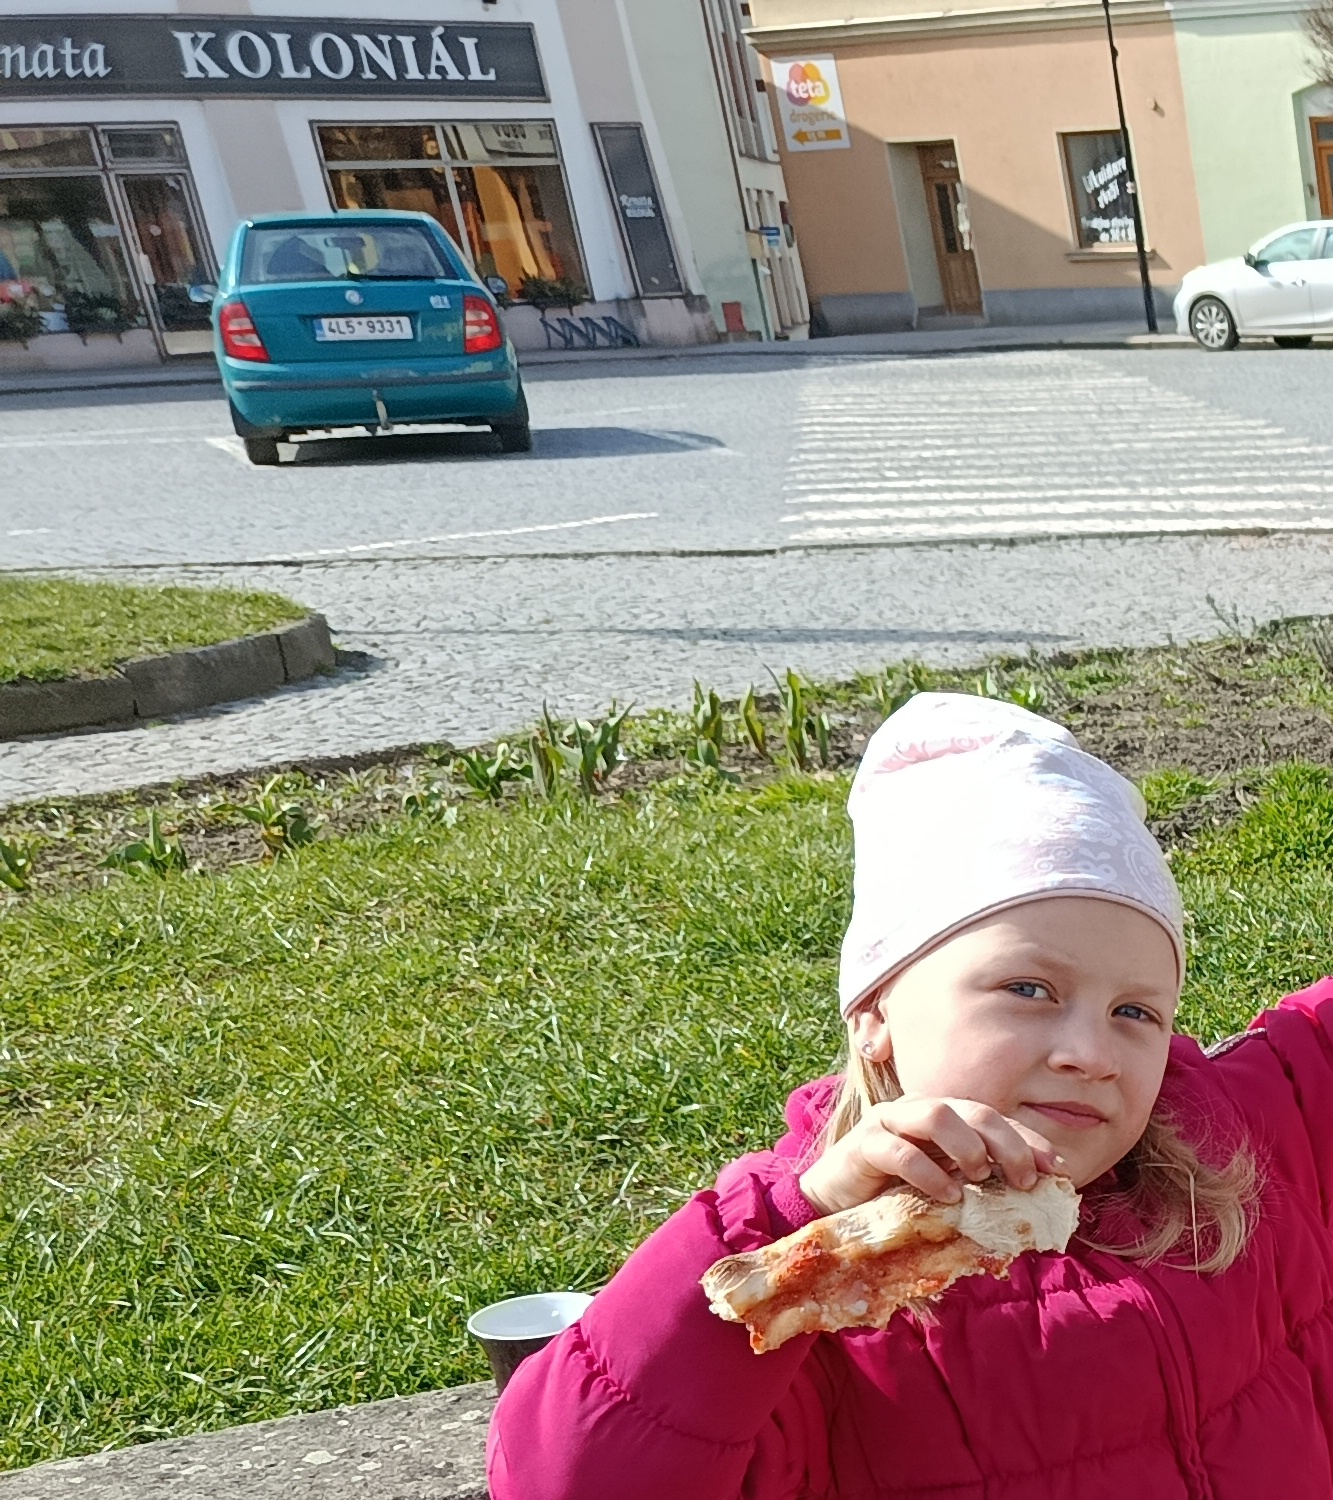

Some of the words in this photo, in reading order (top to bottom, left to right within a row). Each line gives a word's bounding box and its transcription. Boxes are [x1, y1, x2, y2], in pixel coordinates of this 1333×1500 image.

[0, 37, 112, 79] nata
[171, 26, 497, 81] KOLONIÁL
[791, 79, 826, 98] teta
[366, 319, 405, 334] 9331
